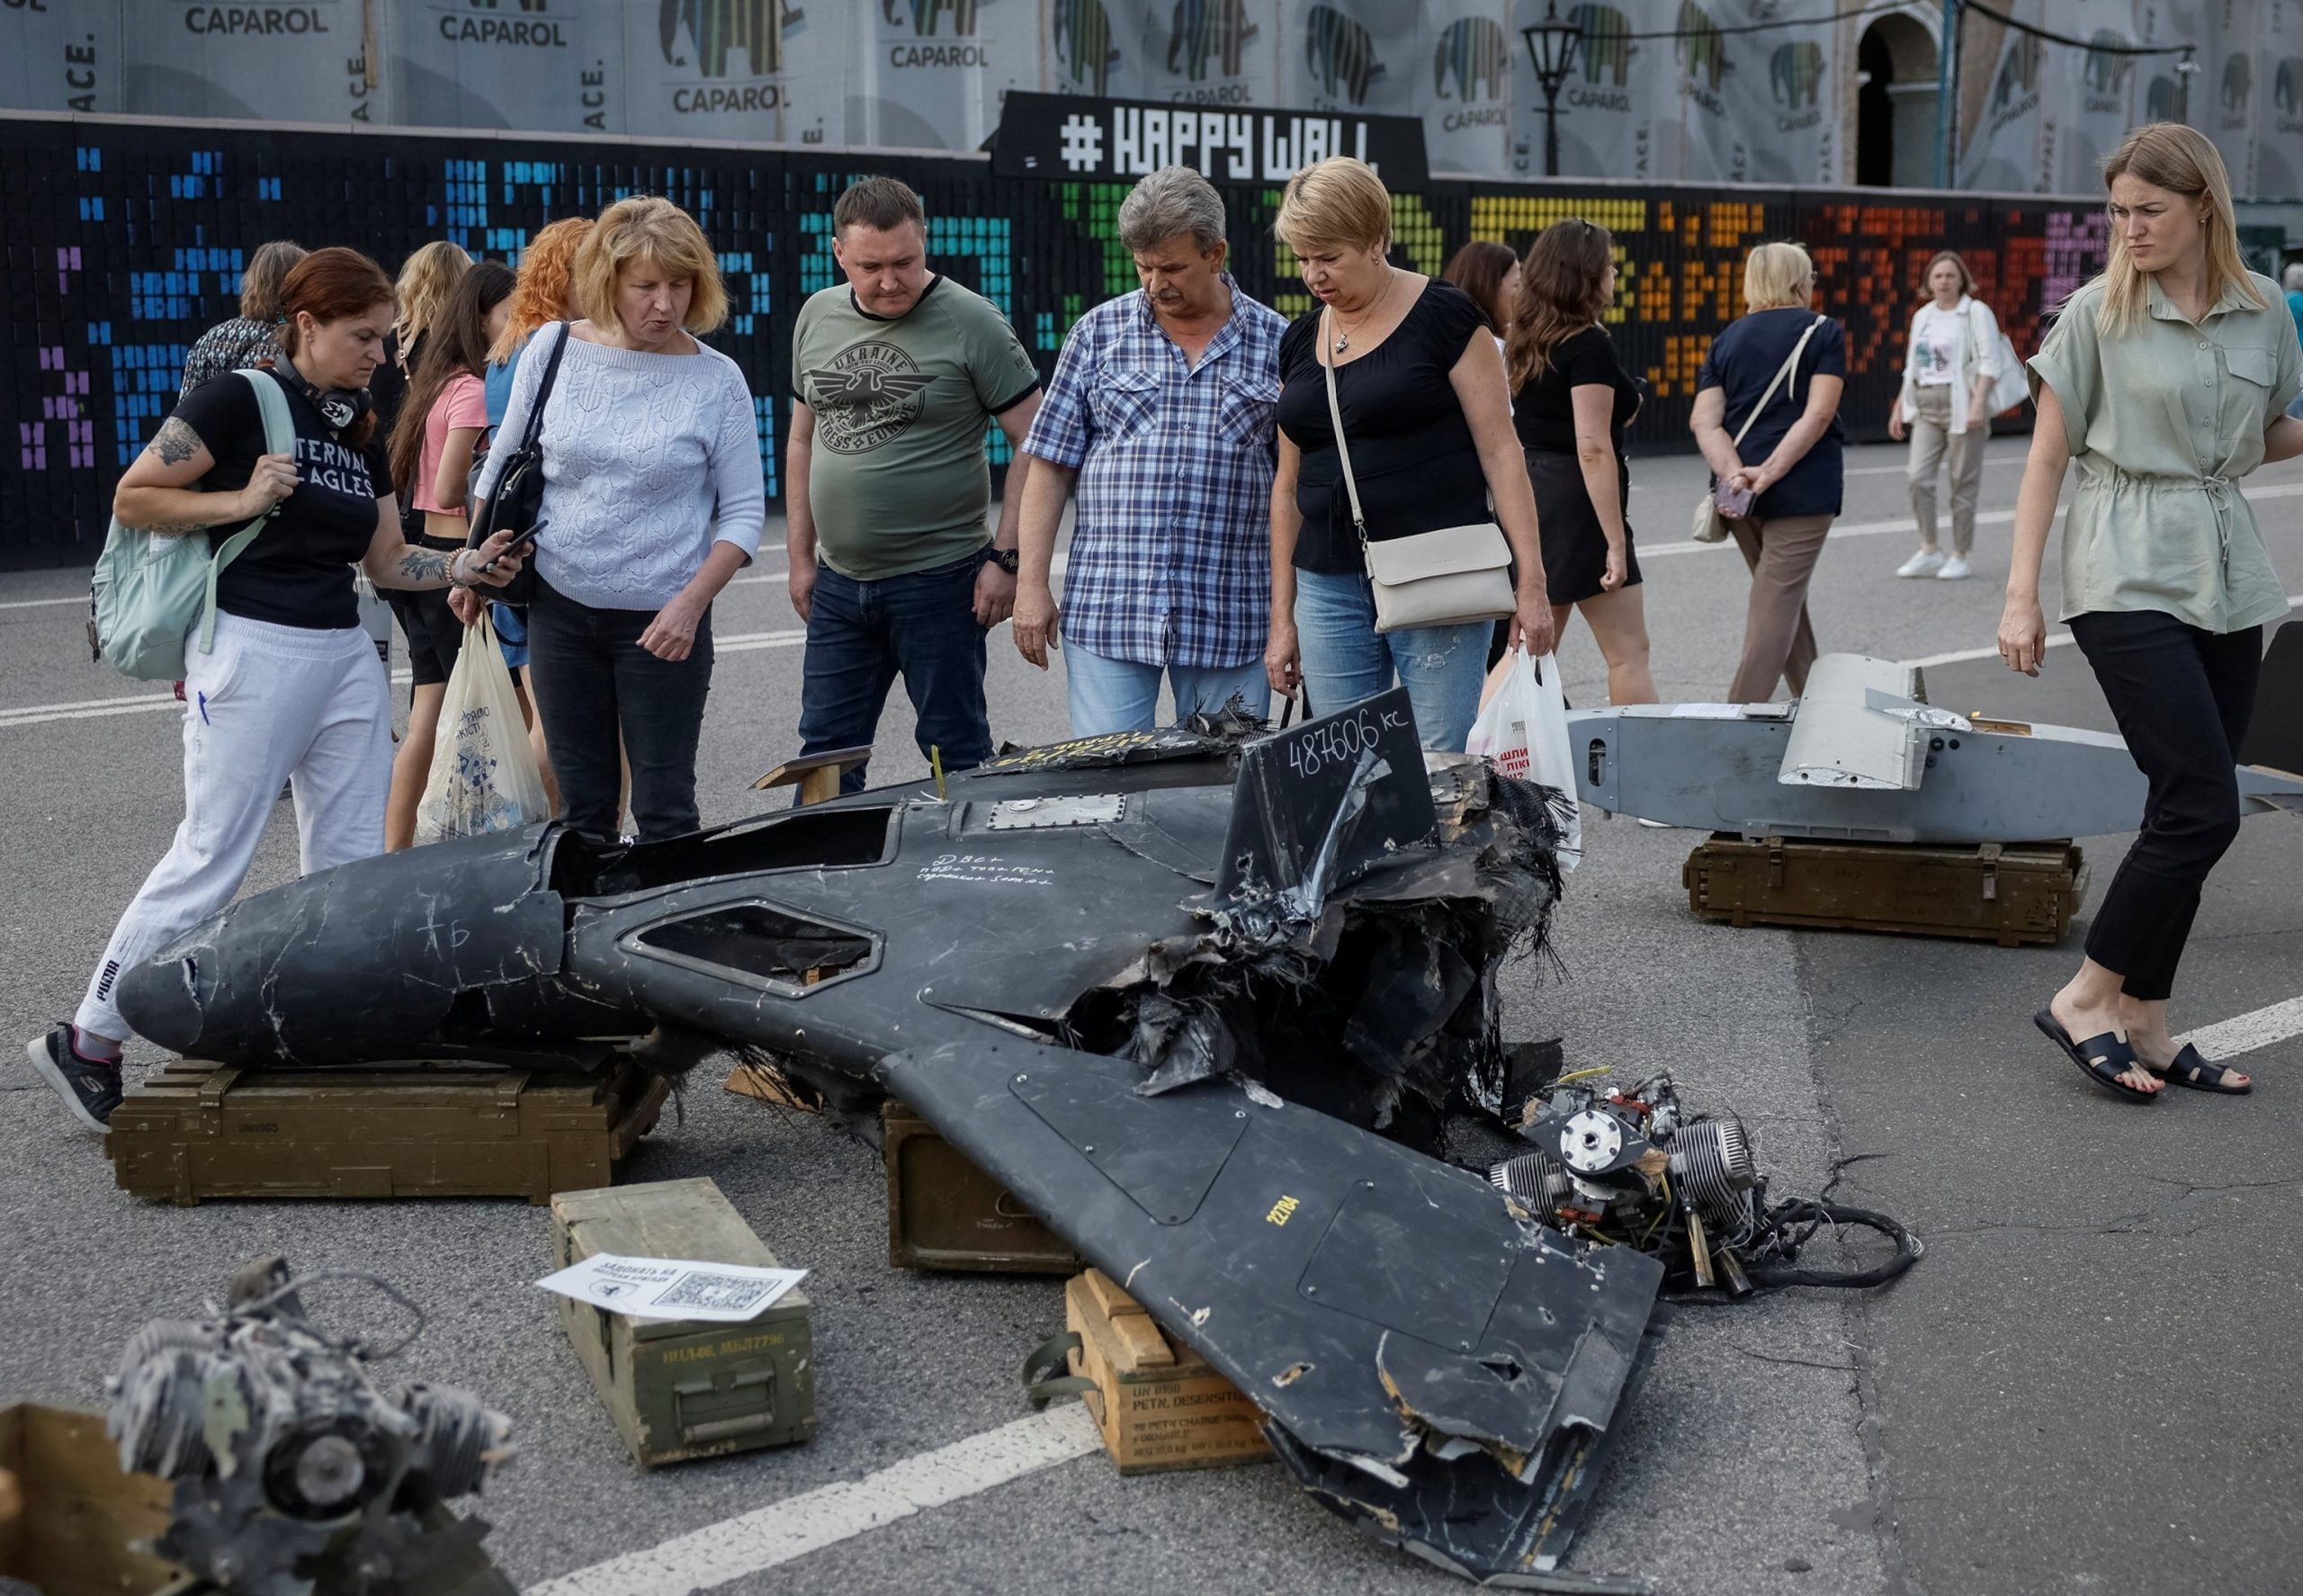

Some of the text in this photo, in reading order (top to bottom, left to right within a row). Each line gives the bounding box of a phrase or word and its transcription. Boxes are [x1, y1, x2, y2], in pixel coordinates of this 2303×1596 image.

[186, 8, 328, 34] CAPAROL
[440, 15, 567, 46] CAPAROL
[891, 46, 989, 68] CAPAROL
[673, 85, 792, 113] CAPAROL
[1172, 84, 1253, 104] CAPAROL
[834, 346, 908, 372] UKRAINE
[295, 462, 375, 499] AGLES
[1290, 708, 1379, 778] 487606
[96, 959, 120, 1002] PUMA
[1133, 1386, 1152, 1397] UN
